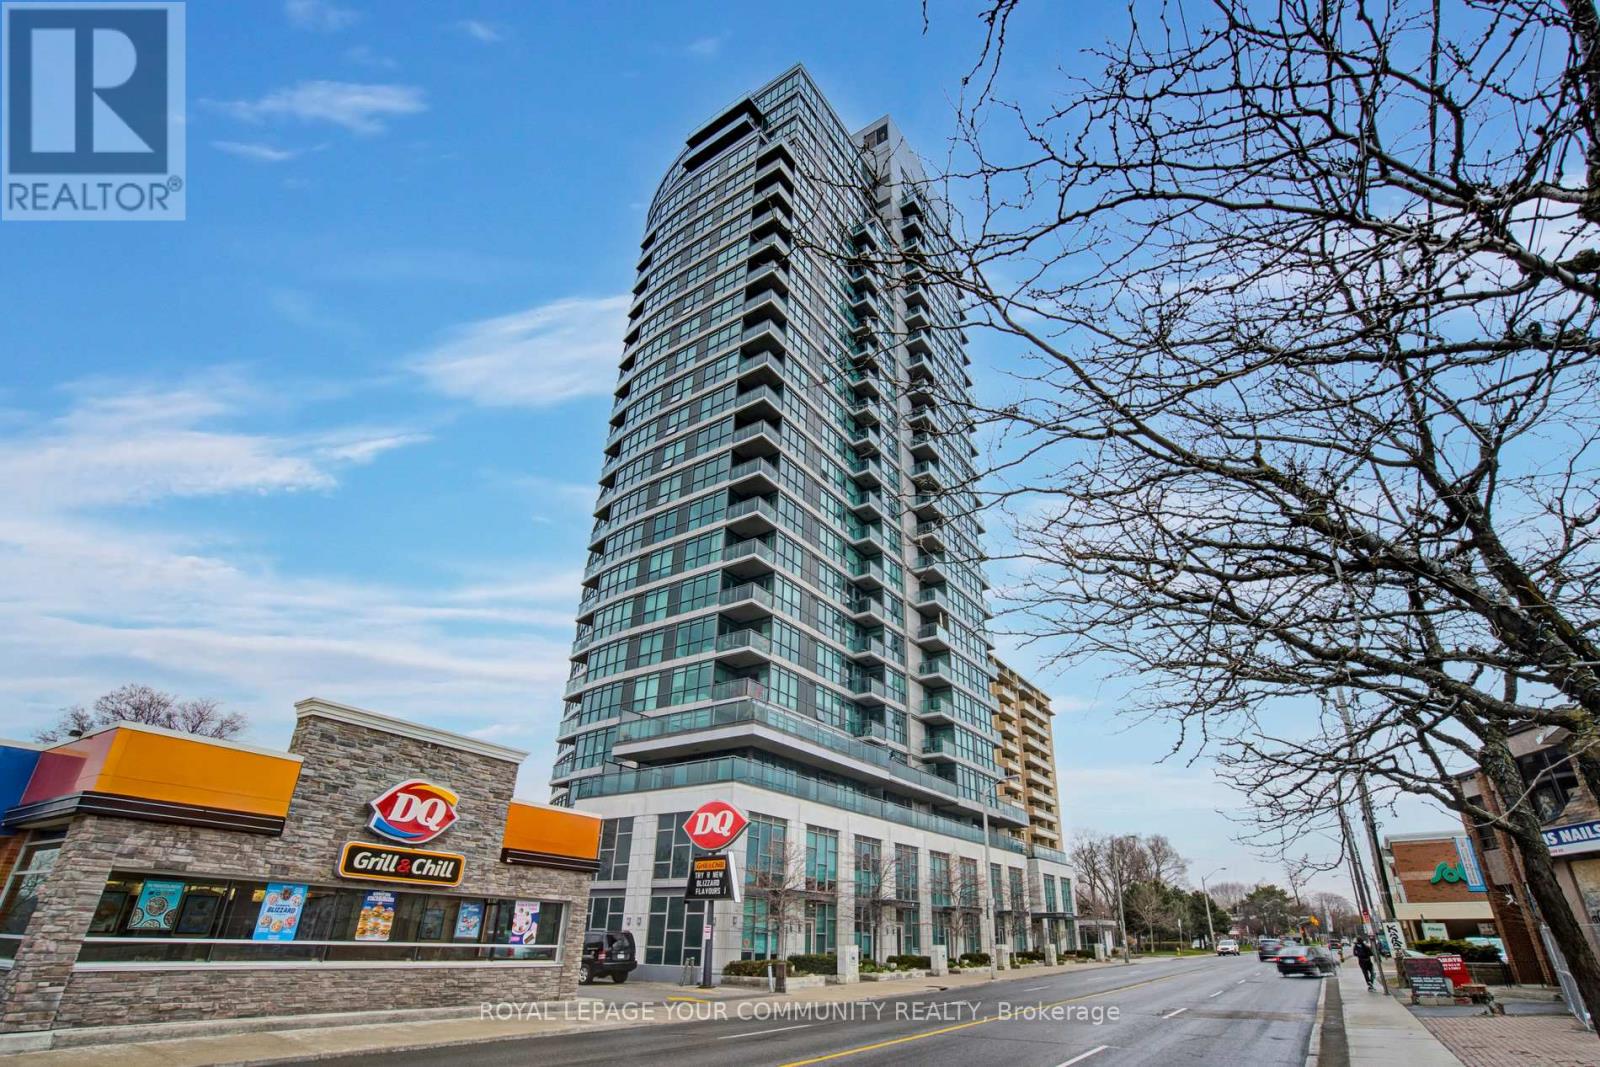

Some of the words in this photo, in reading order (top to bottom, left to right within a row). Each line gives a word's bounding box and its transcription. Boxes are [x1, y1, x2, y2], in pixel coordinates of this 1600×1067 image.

[387, 792, 448, 831] DQ
[693, 810, 734, 837] DQ
[1558, 824, 1600, 843] NAILS
[695, 871, 705, 879] TRY
[712, 870, 724, 879] NEW
[696, 879, 720, 888] BLIZZARD
[695, 887, 721, 896] FLAVOURS
